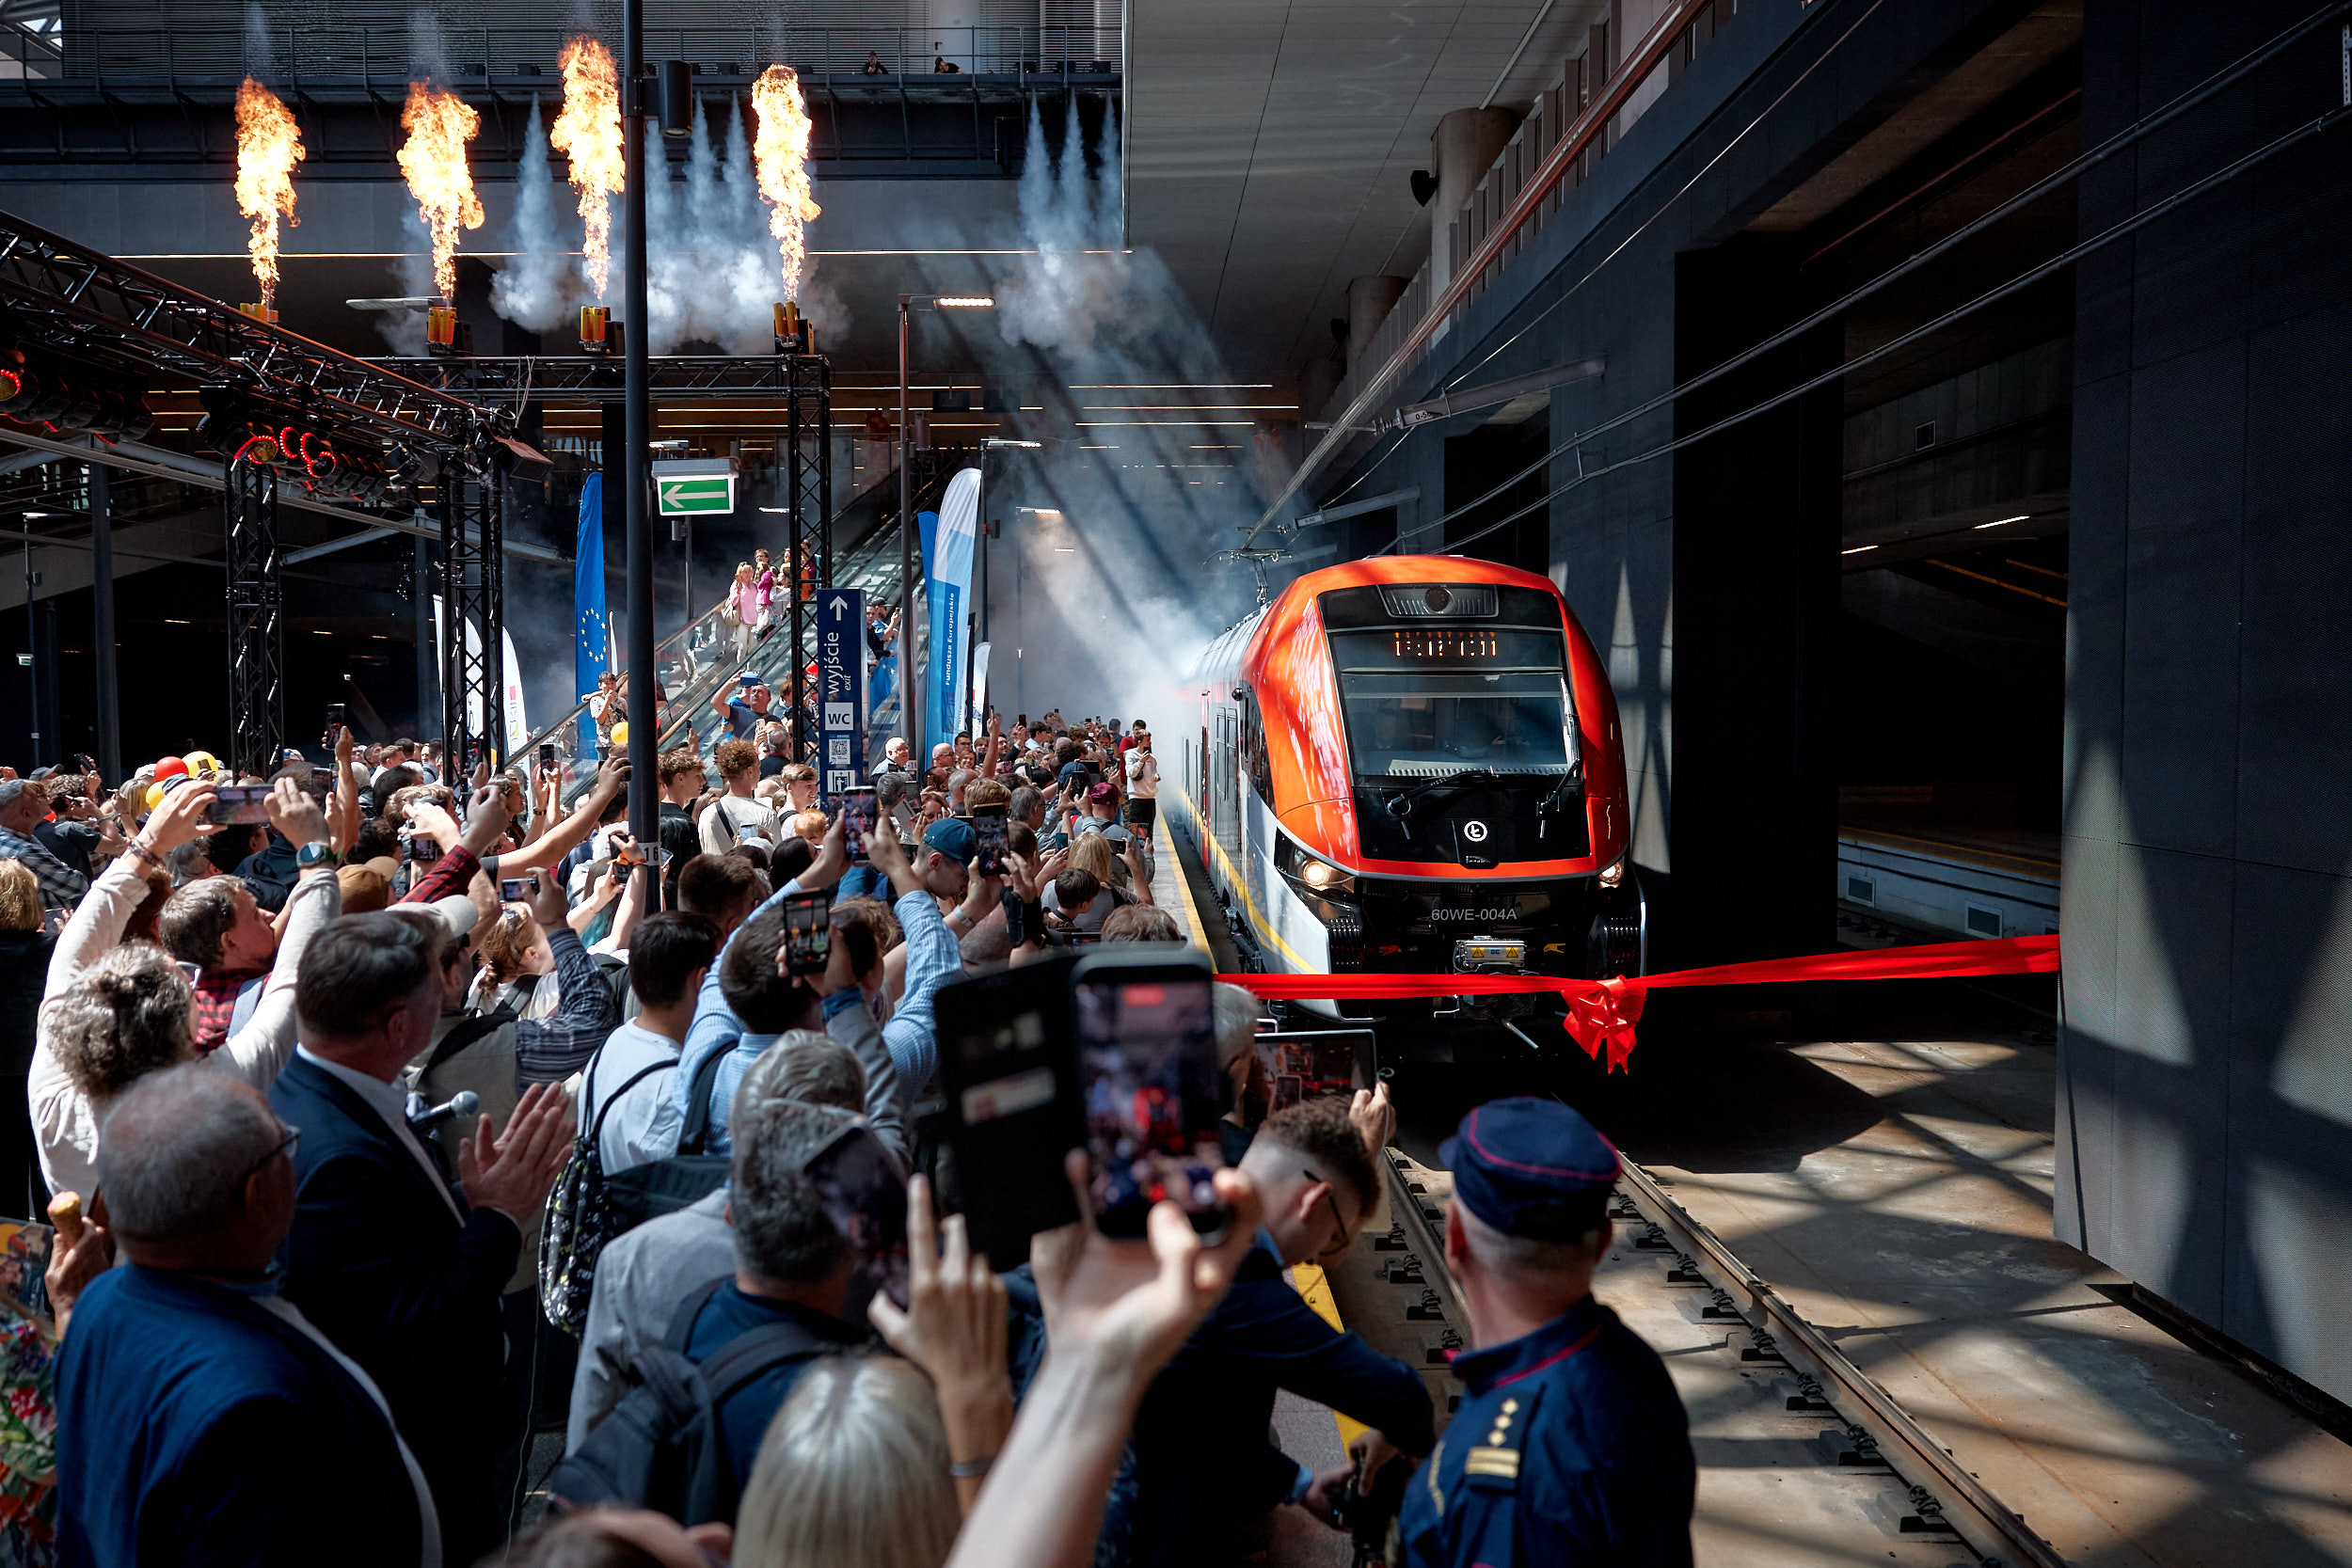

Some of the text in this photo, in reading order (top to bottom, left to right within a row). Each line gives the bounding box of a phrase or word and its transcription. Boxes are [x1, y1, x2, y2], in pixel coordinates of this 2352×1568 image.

[946, 593, 955, 643] Europejskie
[823, 631, 844, 694] wyjście
[842, 674, 851, 691] exit
[828, 713, 850, 725] WC
[1431, 908, 1518, 921] 60WE-004A
